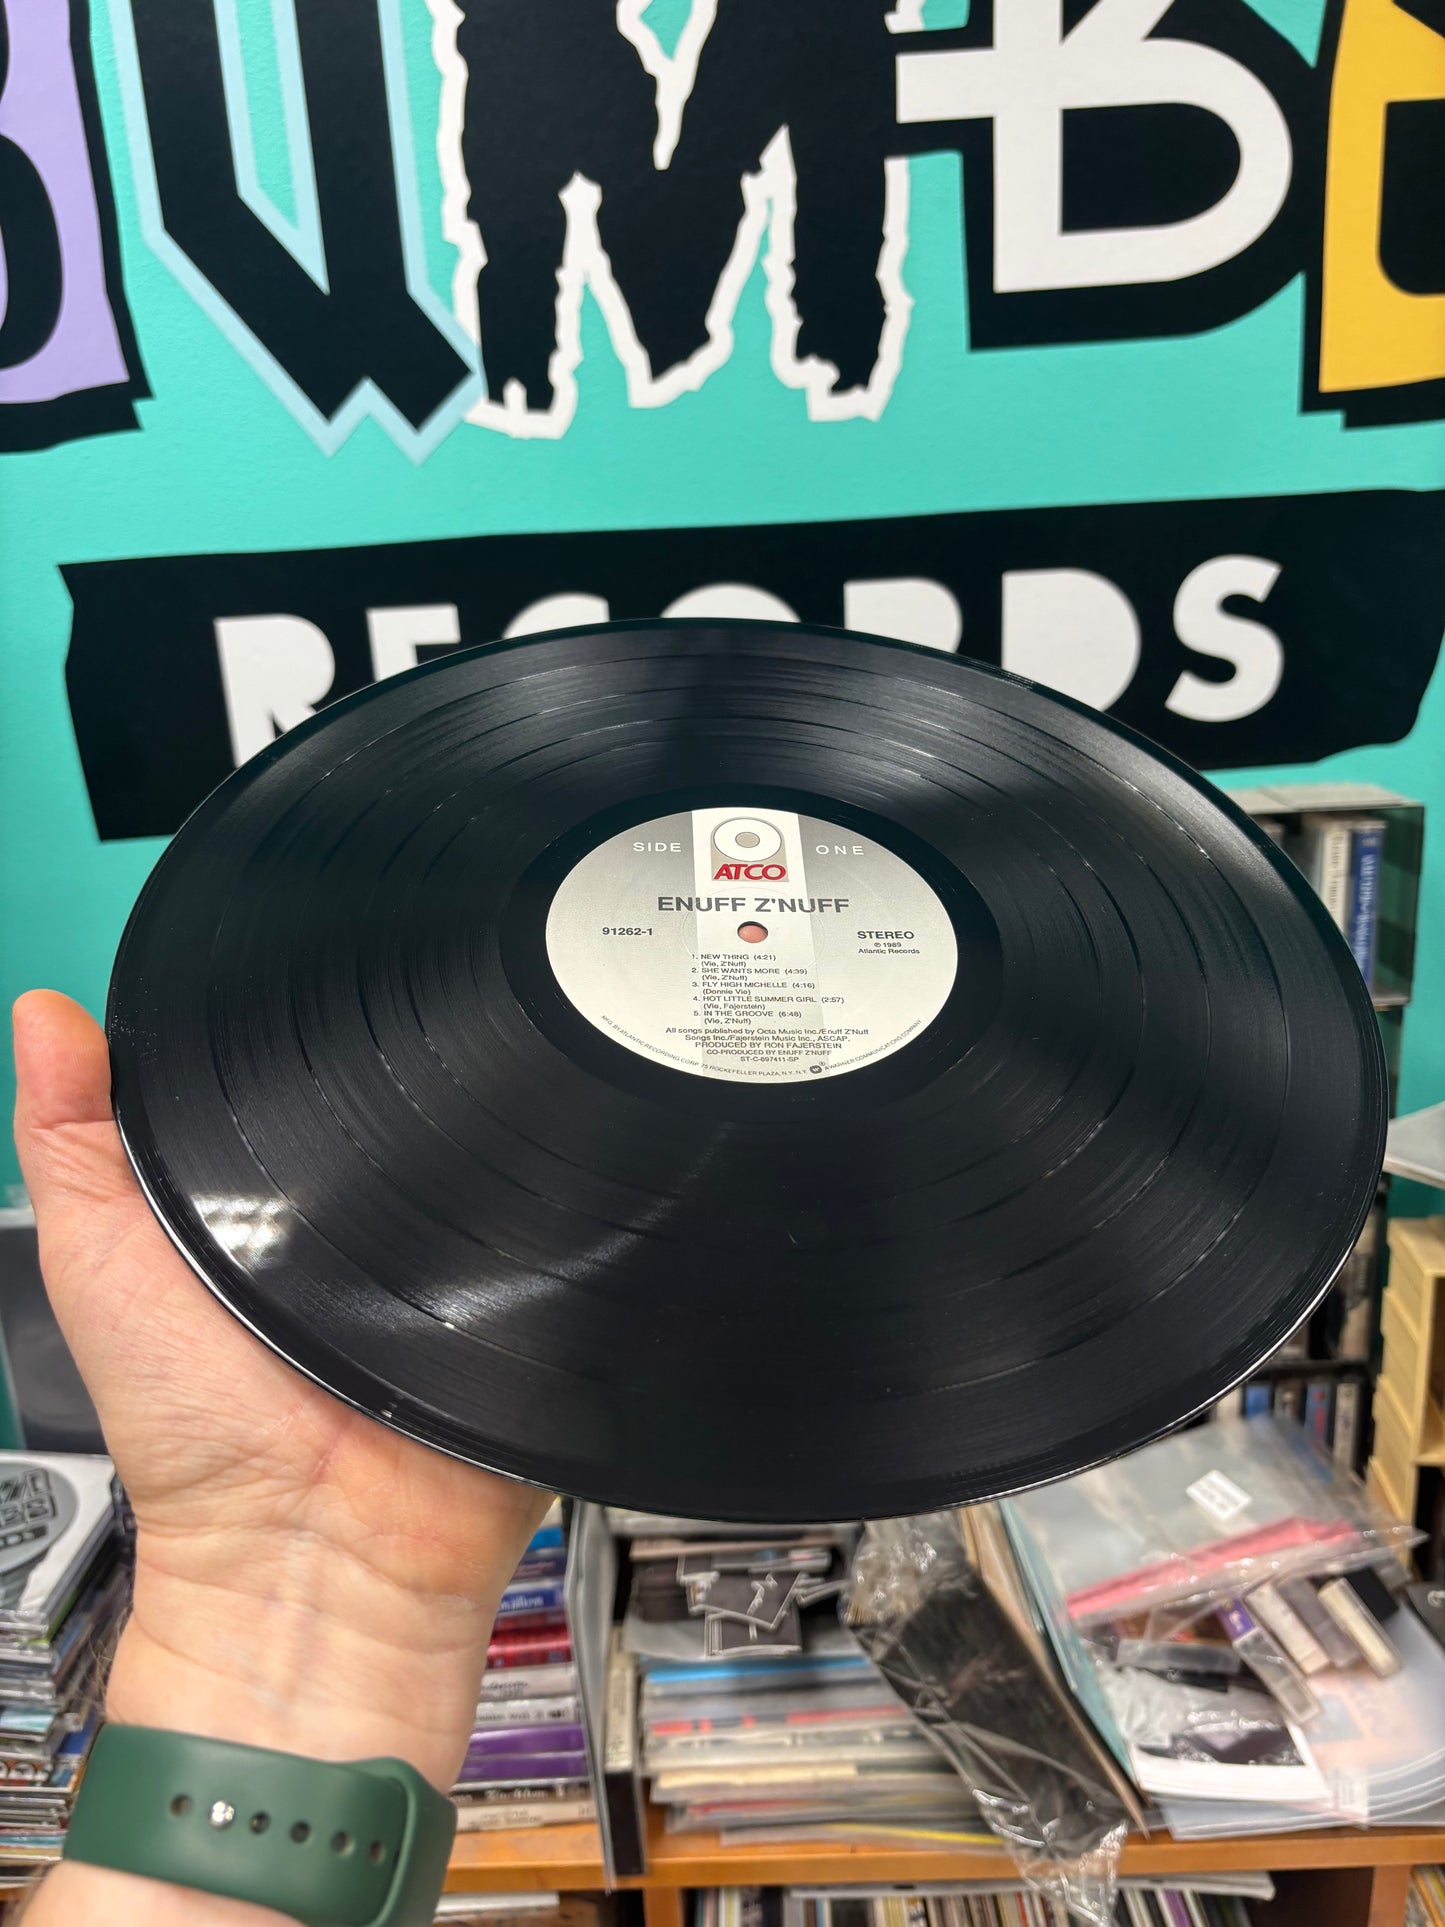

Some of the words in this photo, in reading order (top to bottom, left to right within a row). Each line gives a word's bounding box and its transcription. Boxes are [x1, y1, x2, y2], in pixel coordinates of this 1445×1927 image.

[633, 843, 681, 852] SIDE
[816, 845, 864, 855] ONE
[714, 864, 786, 880] ATCO
[658, 897, 746, 911] ENUFF
[755, 898, 849, 913] Z'NUFF
[602, 927, 653, 935] 91262-1
[857, 931, 914, 940] STEREO
[830, 1059, 855, 1069] WARNER
[900, 1020, 922, 1038] COMPANY
[620, 1030, 645, 1046] ATLANTIC
[644, 1043, 680, 1061] RECORDING
[709, 1065, 757, 1075] ROCKEFELLER
